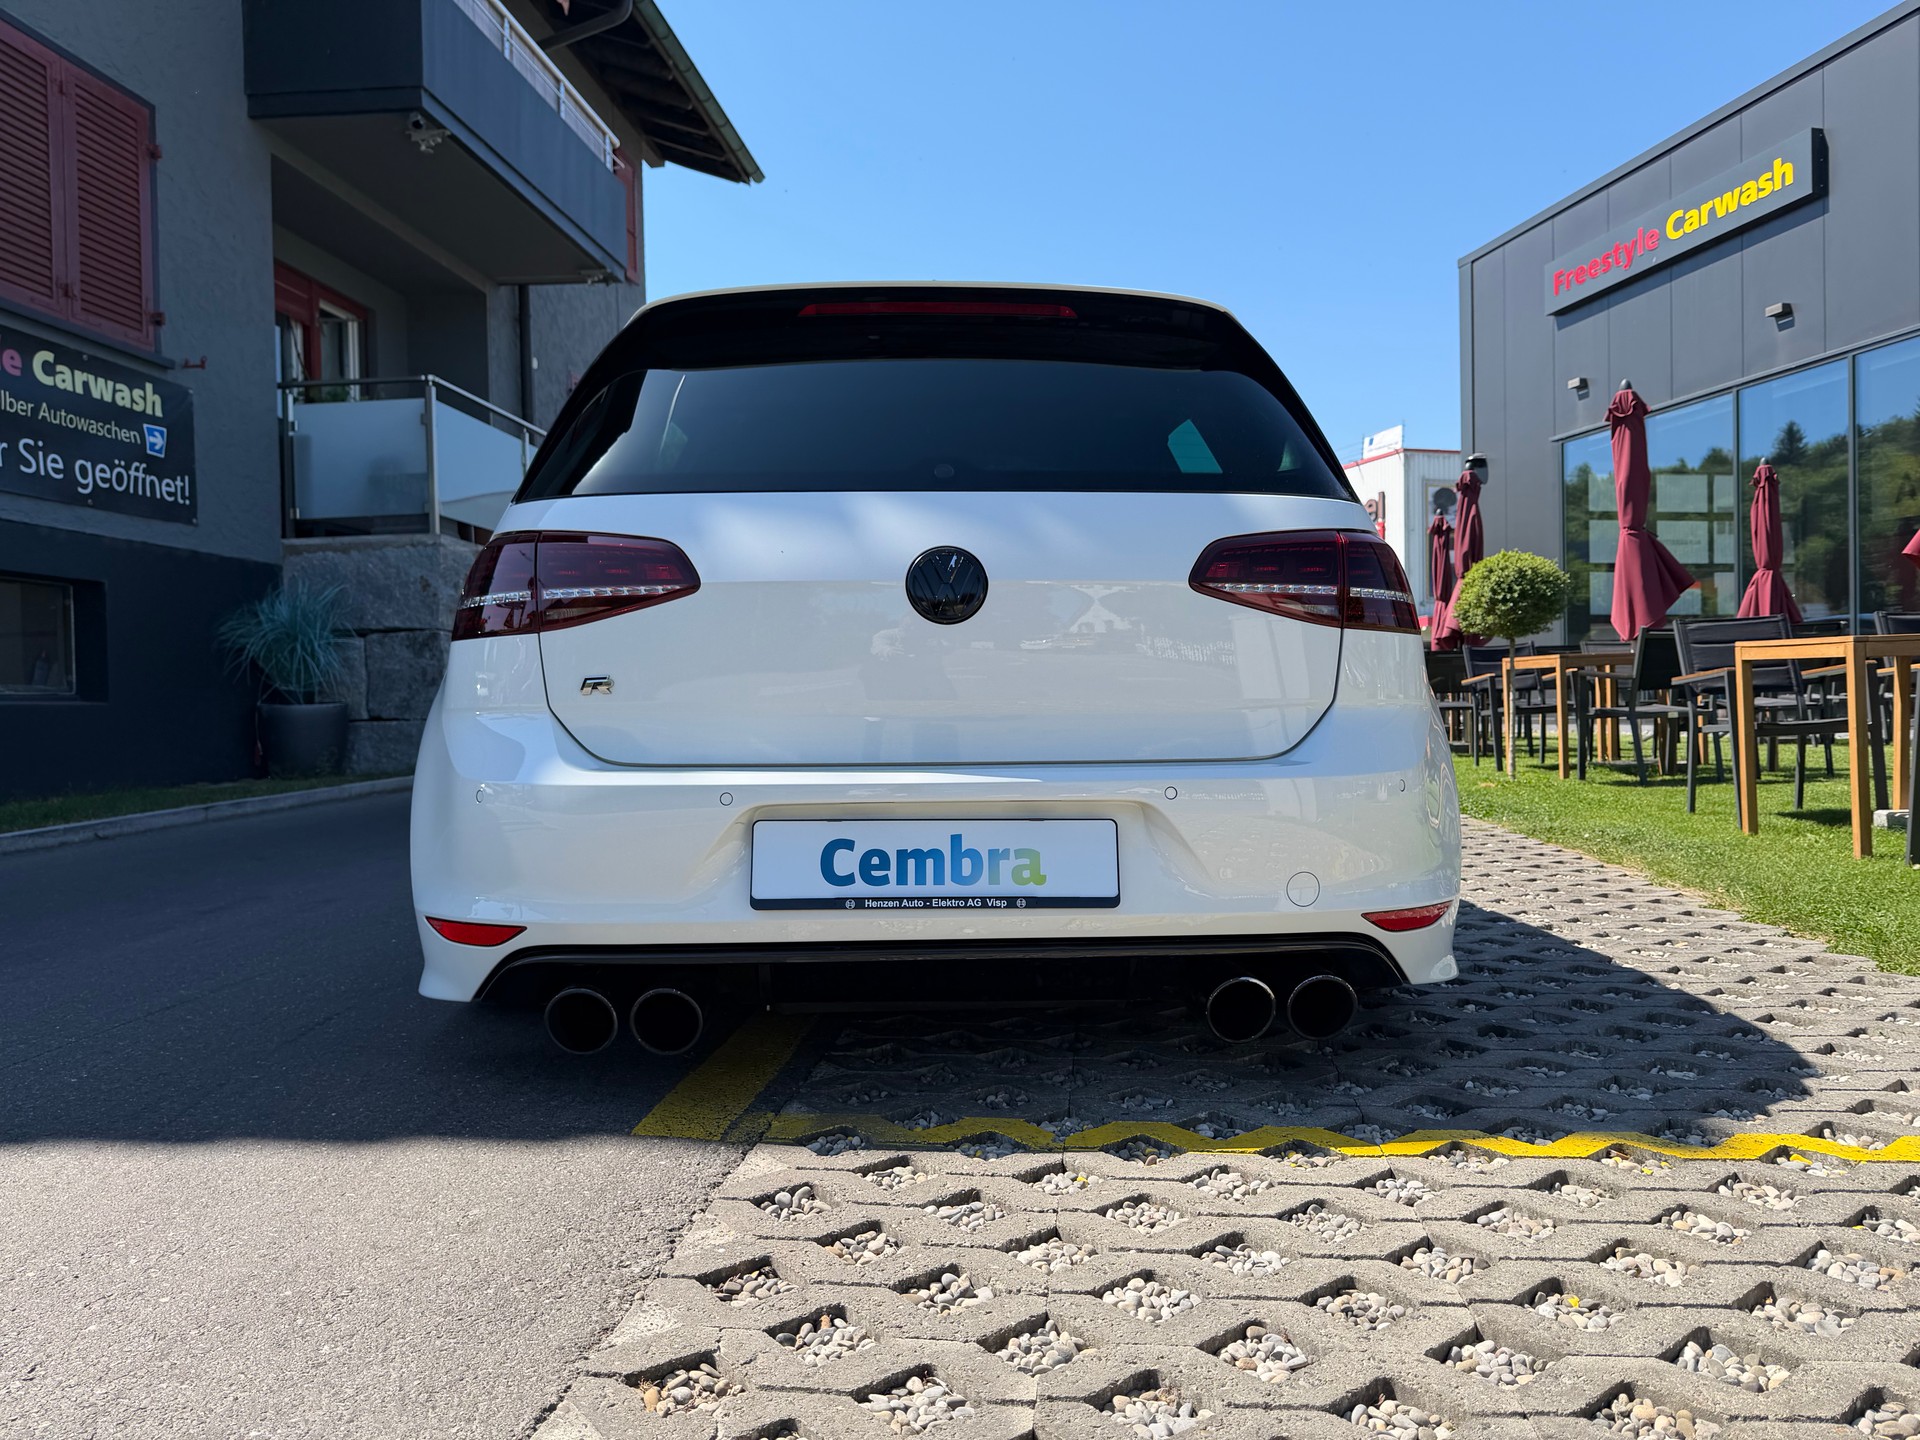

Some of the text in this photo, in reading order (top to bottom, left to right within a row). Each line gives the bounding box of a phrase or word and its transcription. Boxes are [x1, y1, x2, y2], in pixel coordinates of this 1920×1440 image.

[1553, 158, 1794, 296] Freestyle Carwash
[32, 349, 163, 417] Carwash
[38, 402, 141, 445] Autowaschen
[18, 437, 64, 480] Sie
[74, 458, 190, 506] geöffnet!
[820, 833, 1047, 887] Cembra
[864, 899, 900, 908] Henzen
[901, 899, 924, 908] Auto
[932, 898, 965, 907] Elektro
[966, 898, 982, 907] AG
[986, 898, 1007, 909] Visp
